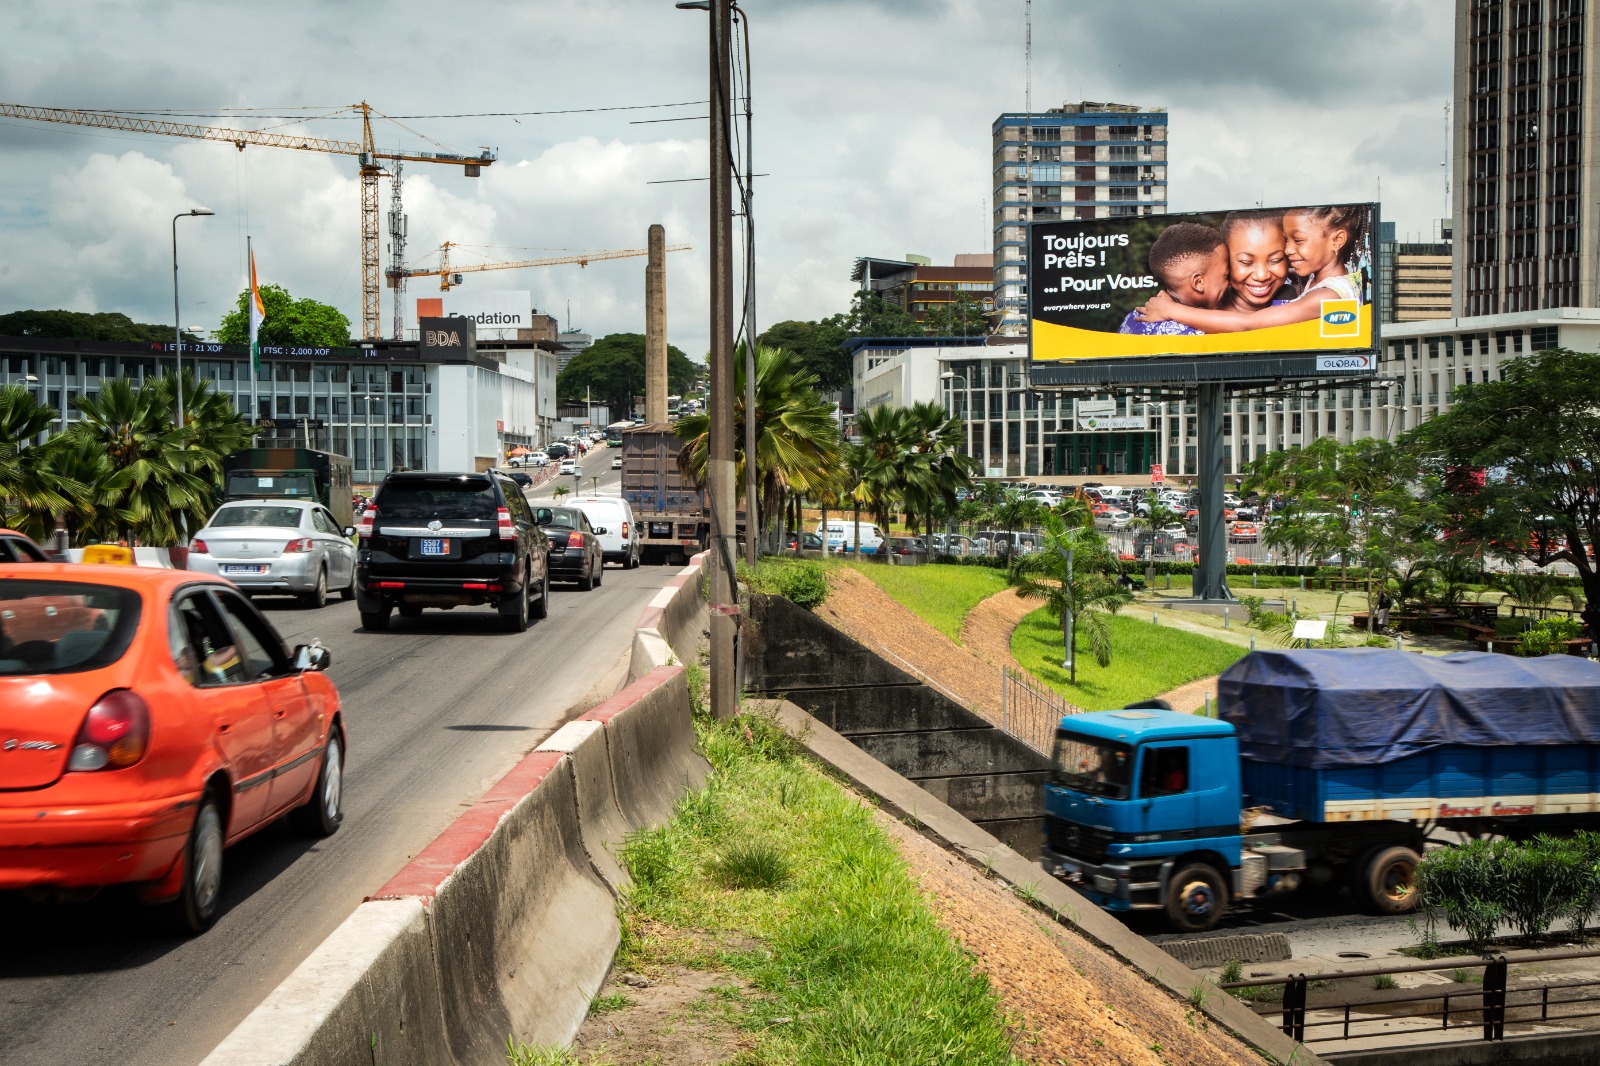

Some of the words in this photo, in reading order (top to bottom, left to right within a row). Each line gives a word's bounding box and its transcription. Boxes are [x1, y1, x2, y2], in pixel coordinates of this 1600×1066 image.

[1043, 232, 1129, 252] Toujours
[1044, 251, 1095, 269] Prêts
[1061, 277, 1106, 292] Pour
[1106, 274, 1159, 290] Vous.
[1043, 303, 1085, 312] everywhere
[1085, 303, 1100, 311] you
[1100, 302, 1111, 310] go
[1329, 313, 1351, 322] MTN
[425, 330, 461, 347] BDA
[195, 344, 205, 352] 21
[207, 344, 223, 353] XOF
[263, 346, 283, 354] FTSC
[291, 347, 313, 356] 2,000
[314, 348, 331, 356] XOF
[1323, 360, 1361, 368] GLOBAL
